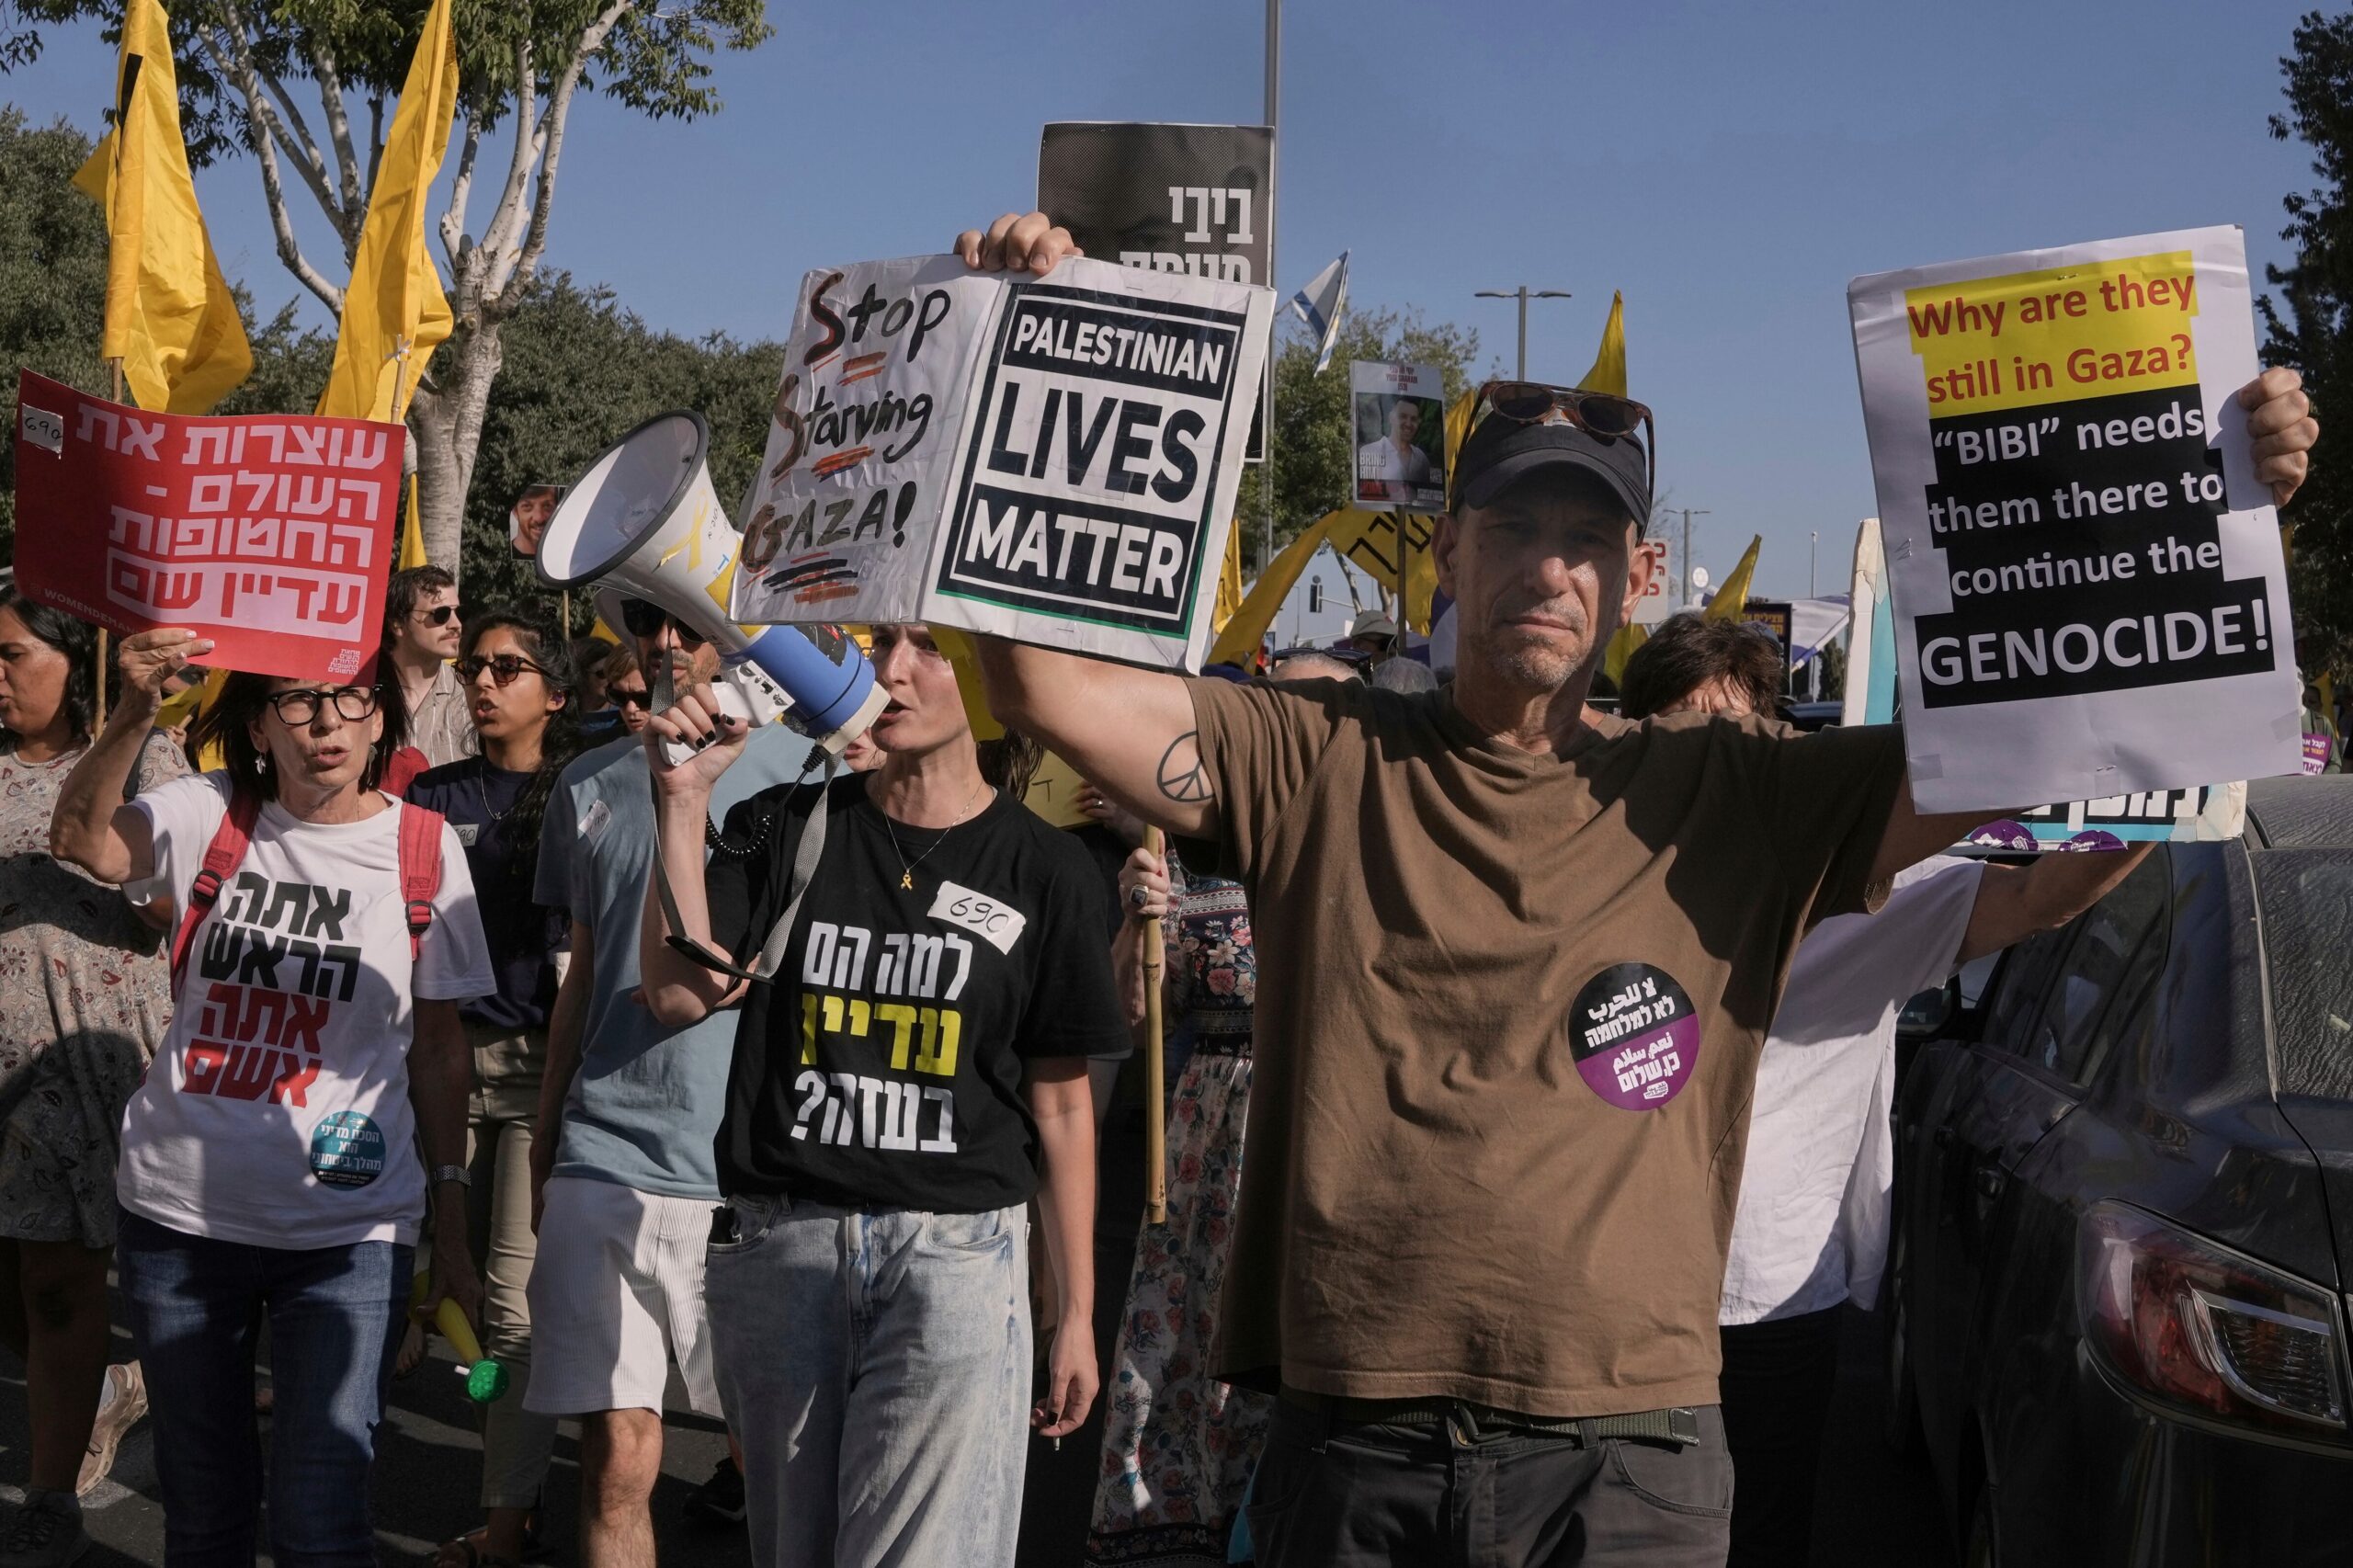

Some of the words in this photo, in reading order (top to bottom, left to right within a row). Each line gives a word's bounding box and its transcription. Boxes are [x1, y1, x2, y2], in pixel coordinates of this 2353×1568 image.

[1169, 187, 1253, 244] ביבי
[803, 271, 951, 367] Stop
[1907, 296, 2006, 338] Why
[2020, 289, 2087, 324] are
[2100, 273, 2194, 312] they
[1013, 313, 1225, 384] PALESTINIAN
[1928, 358, 2000, 403] still
[2015, 356, 2053, 392] in
[2067, 333, 2192, 384] Gaza?
[76, 402, 165, 461] את
[181, 425, 388, 470] עוצרות
[771, 373, 934, 478] Starving
[986, 381, 1206, 503] LIVES
[2076, 401, 2205, 450] needs
[1359, 452, 1386, 467] BRING
[1359, 466, 1377, 480] HIM
[188, 470, 381, 521] העולם
[1929, 495, 2040, 533] them
[2052, 479, 2168, 520] there
[2179, 472, 2223, 504] to
[108, 505, 374, 568] החטופות
[740, 480, 917, 573] GAZA!
[964, 498, 1184, 599] MATTER
[110, 556, 203, 609] שם
[1950, 551, 2136, 597] continue
[2148, 537, 2221, 570] the
[221, 572, 361, 625] עדיין
[1921, 598, 2269, 687] GENOCIDE!
[455, 828, 476, 842] 90
[222, 871, 352, 941] אתה
[949, 896, 1009, 934] 690
[199, 922, 362, 1003] הראש
[802, 920, 872, 991] הם
[874, 932, 973, 1001] למה
[1587, 983, 1642, 1023] للحرب
[1642, 977, 1657, 998] لا
[1653, 994, 1676, 1020] לא
[199, 983, 330, 1054] אתה
[801, 993, 961, 1076] עדיין
[1585, 1005, 1653, 1049] למלחמה
[181, 1038, 323, 1108] אשם
[1612, 1047, 1647, 1075] سلام
[1617, 1059, 1664, 1093] שלום
[321, 1124, 349, 1139] מדיני
[790, 1070, 958, 1153] בעזה?
[338, 1141, 359, 1154] הוא
[354, 1156, 381, 1171] מהלך
